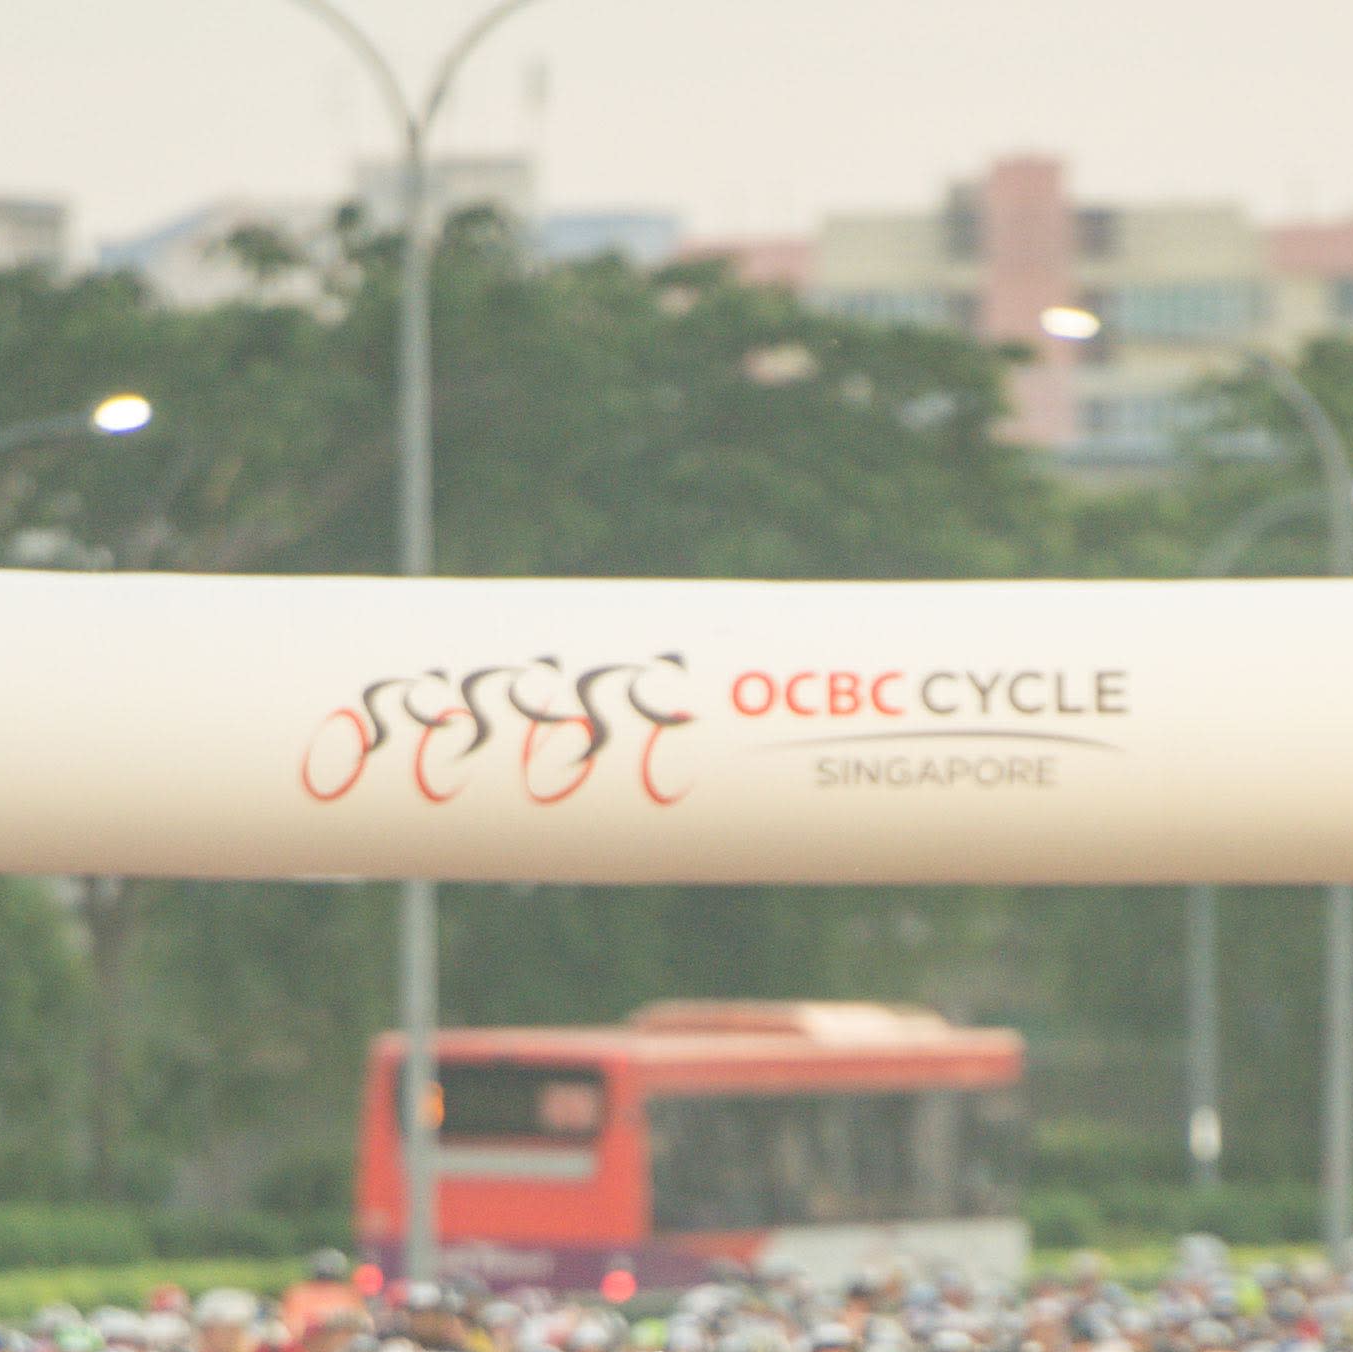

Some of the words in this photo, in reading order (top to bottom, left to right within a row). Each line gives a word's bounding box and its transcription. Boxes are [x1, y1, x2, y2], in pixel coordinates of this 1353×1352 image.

[731, 669, 906, 719] OCBC
[920, 669, 1130, 718] CYCLE
[814, 754, 1058, 790] SINGAPORE
